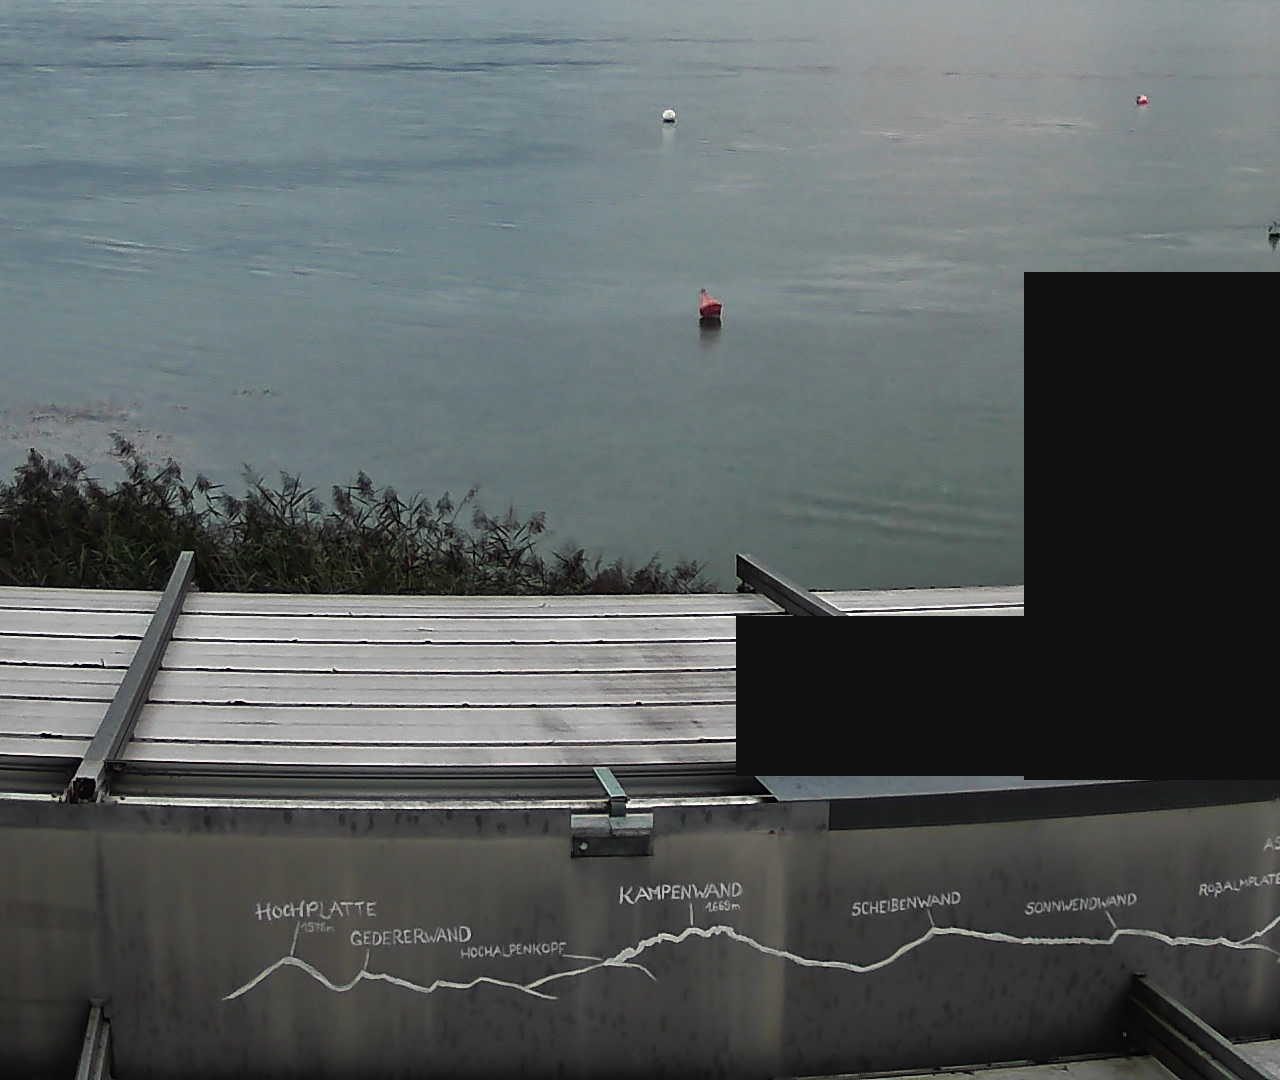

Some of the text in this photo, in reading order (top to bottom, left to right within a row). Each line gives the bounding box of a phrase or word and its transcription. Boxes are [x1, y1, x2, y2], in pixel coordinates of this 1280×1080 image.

[619, 881, 742, 905] KAMPENWAND
[851, 891, 961, 917] SCHEIBENWAND
[1024, 892, 1137, 916] SONNWENDWAND
[255, 900, 377, 921] HOCHPLATTE
[350, 925, 472, 947] GEDERERWAND
[460, 942, 568, 960] HOCHALPENKOPF
